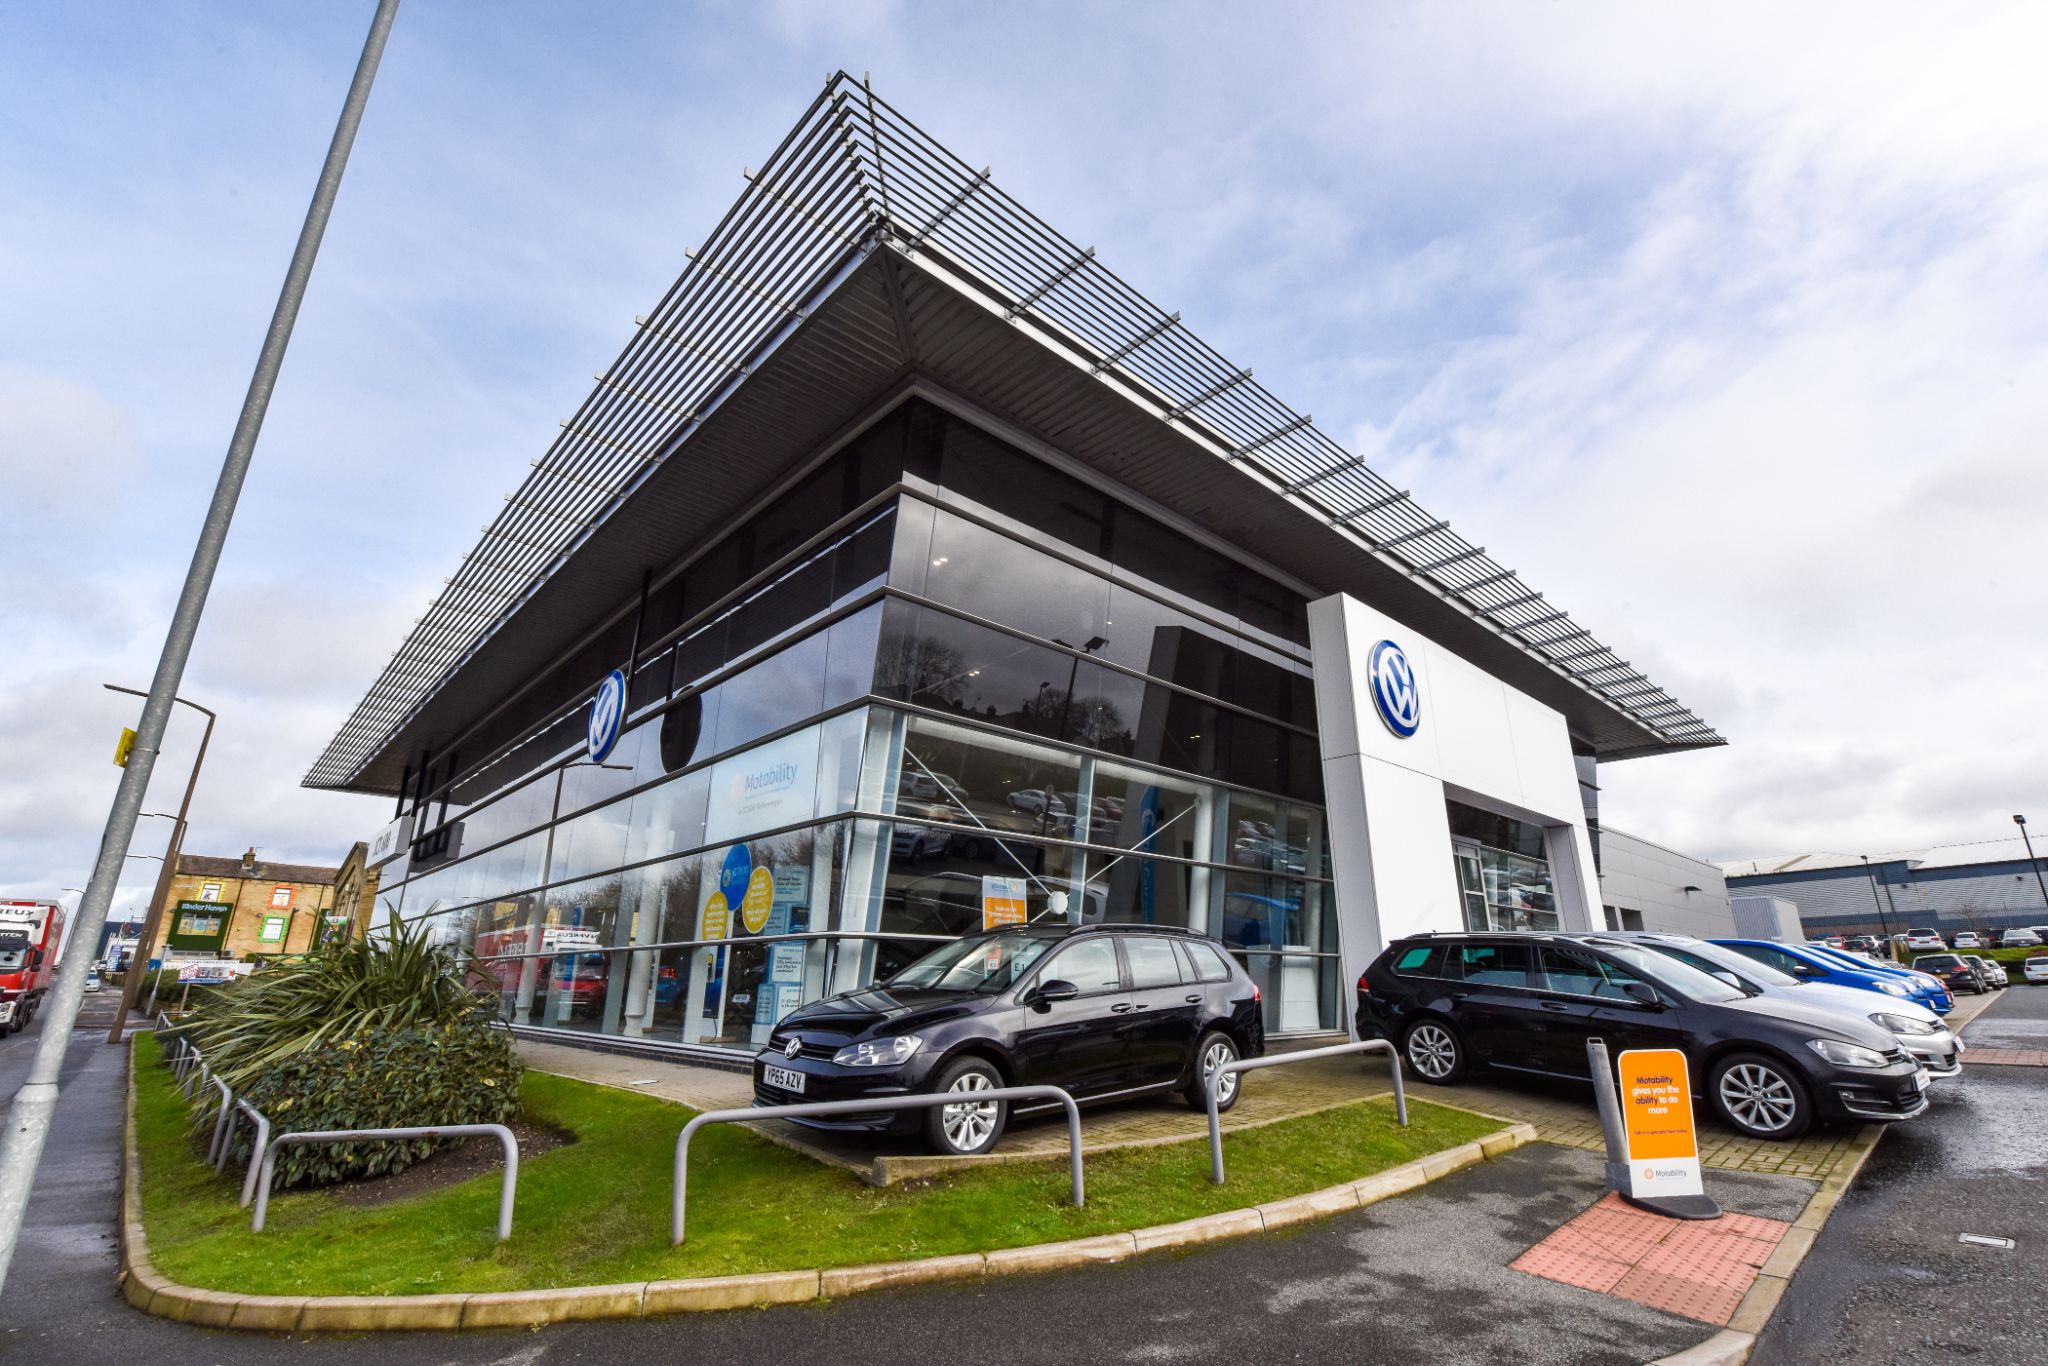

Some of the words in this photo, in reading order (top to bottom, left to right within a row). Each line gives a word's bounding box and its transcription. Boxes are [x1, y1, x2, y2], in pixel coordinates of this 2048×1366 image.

[744, 762, 798, 792] Motability
[181, 903, 204, 911] Kinder
[204, 904, 228, 912] Haven
[768, 1067, 784, 1085] YP65
[786, 1070, 802, 1089] AZV
[1636, 1076, 1673, 1085] Motability
[1632, 1086, 1651, 1097] gives
[1652, 1087, 1666, 1096] you
[1667, 1084, 1680, 1094] the
[1636, 1096, 1658, 1105] ability
[1659, 1096, 1668, 1104] to
[1668, 1095, 1679, 1104] do
[1647, 1107, 1669, 1115] more
[1655, 1168, 1688, 1178] Motability
